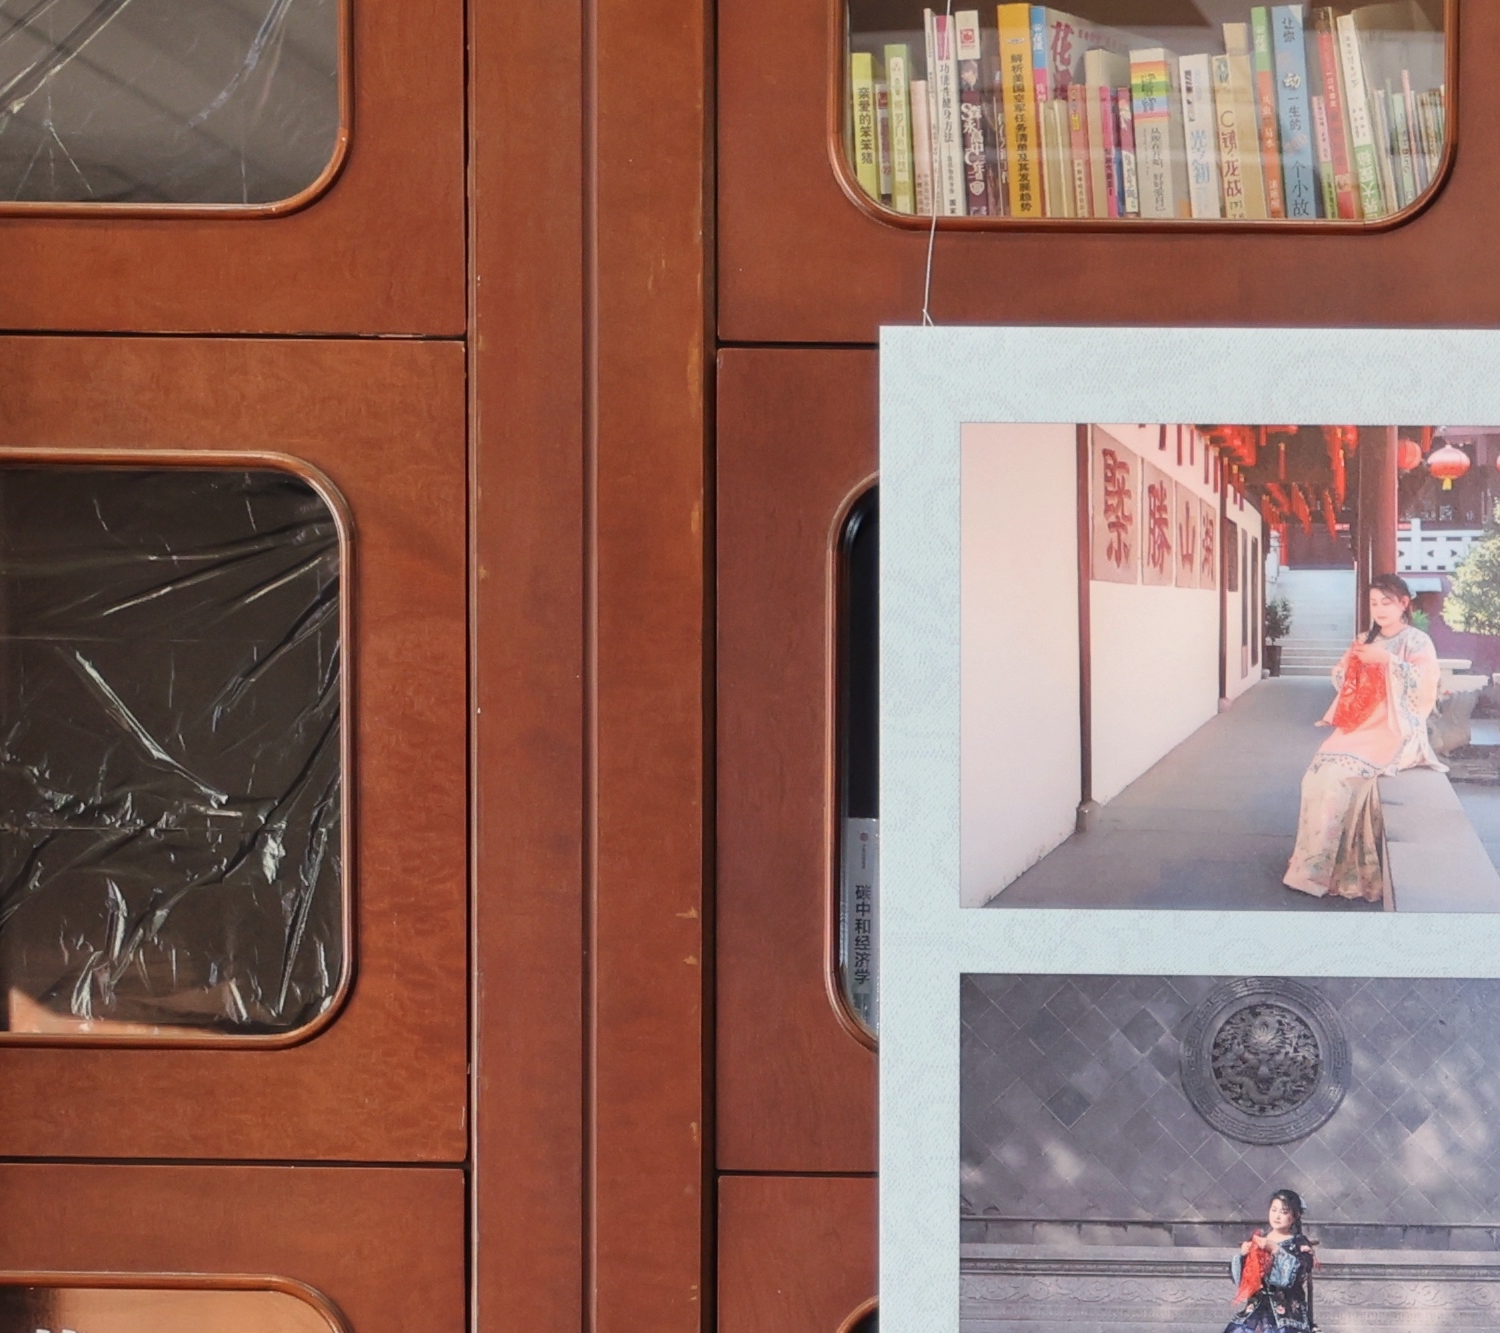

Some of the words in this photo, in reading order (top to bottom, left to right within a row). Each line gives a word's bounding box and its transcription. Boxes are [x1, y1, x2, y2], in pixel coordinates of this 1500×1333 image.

[854, 885, 871, 985] 碳中和经济学
